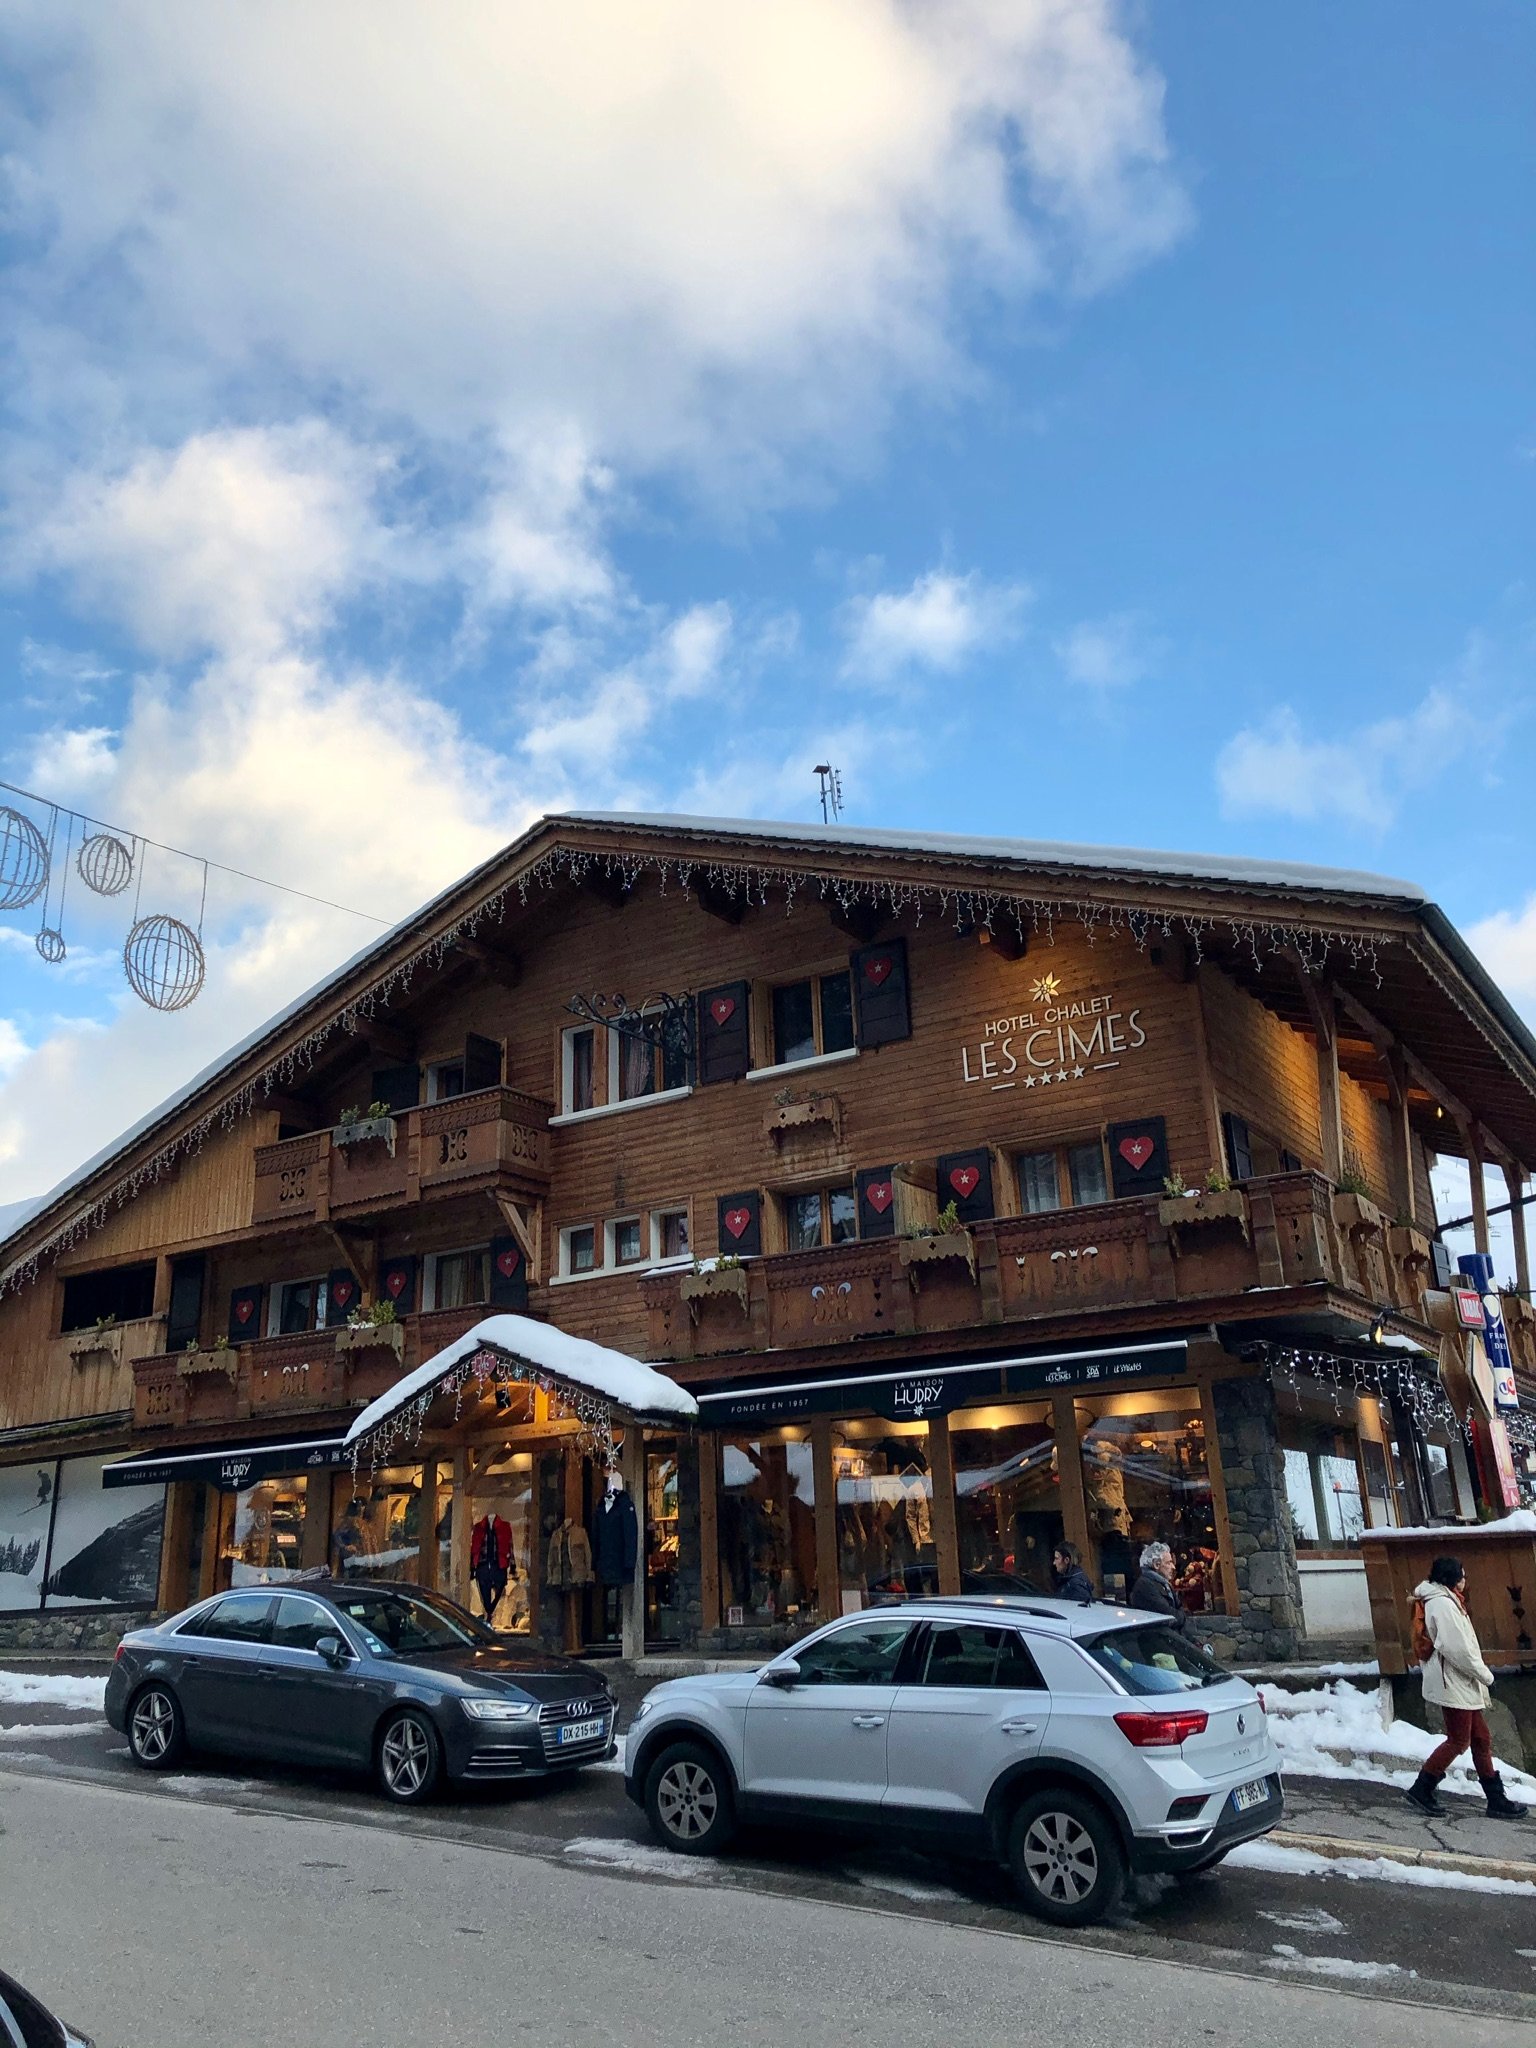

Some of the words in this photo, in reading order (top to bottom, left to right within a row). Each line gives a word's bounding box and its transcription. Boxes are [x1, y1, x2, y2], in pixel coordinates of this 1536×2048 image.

[985, 1013, 1039, 1037] HOTEL
[1044, 995, 1113, 1023] CHALET
[962, 1037, 1017, 1083] LES
[1025, 1009, 1146, 1067] CIMES
[1087, 1367, 1100, 1376] SPA
[894, 1382, 906, 1390] LA
[909, 1378, 944, 1389] MAISON
[894, 1386, 943, 1406] HUDRY
[731, 1402, 766, 1413] FONDÉE
[771, 1401, 783, 1409] EN
[788, 1399, 809, 1408] 1957
[221, 1463, 251, 1478] HUDRY
